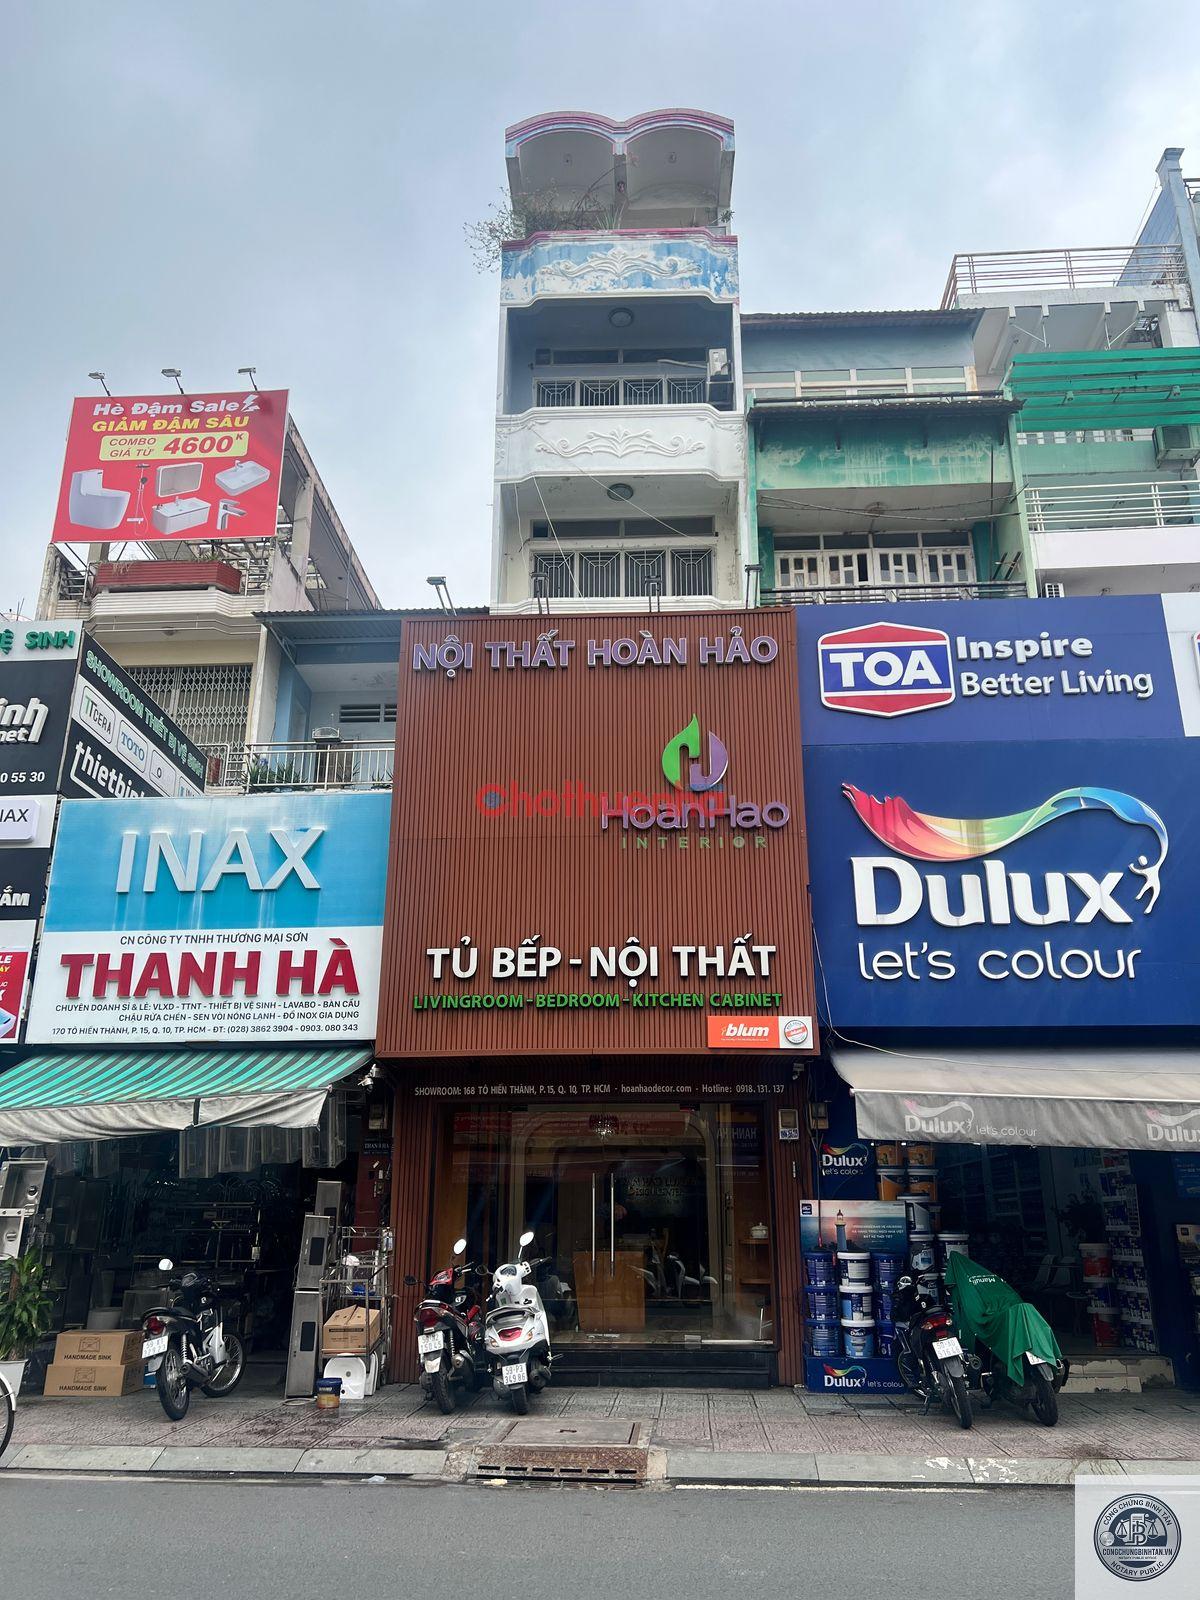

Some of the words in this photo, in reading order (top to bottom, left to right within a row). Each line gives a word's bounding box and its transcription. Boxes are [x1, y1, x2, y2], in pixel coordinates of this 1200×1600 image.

[93, 403, 125, 416] Hè
[131, 402, 183, 418] Đậm
[189, 399, 240, 413] Sale
[92, 416, 148, 432] GIẢM
[152, 416, 200, 433] ĐẬM
[205, 414, 250, 429] SÂU
[109, 438, 157, 447] COMBO
[109, 448, 132, 458] GIÁ
[25, 630, 76, 650] SINH
[956, 631, 1094, 665] Inspire
[412, 634, 473, 678] NỘI
[485, 629, 576, 669] THẤT
[587, 630, 687, 667] HOÀN
[700, 626, 779, 665] HẢO
[829, 649, 942, 688] TOA
[86, 650, 144, 718] SHOWROOM
[960, 671, 1055, 697] Better
[1060, 669, 1154, 699] Living
[121, 731, 145, 762] TOTO
[11, 772, 26, 783] 55
[30, 771, 45, 782] 30
[0, 808, 29, 822] AX
[601, 794, 791, 831] HoanHao
[622, 836, 768, 850] INTERIOR
[115, 828, 326, 894] INAX
[0, 885, 30, 907] ẮM
[850, 856, 1134, 927] Dulux
[120, 936, 135, 945] CN
[137, 934, 167, 945] CÔNG
[170, 935, 182, 944] TY
[185, 934, 214, 944] TNHH
[216, 933, 262, 944] THƯƠNG
[263, 933, 284, 945] MẠI
[285, 932, 309, 942] SƠN
[60, 950, 262, 1000] THANH
[275, 937, 361, 997] HÀ
[426, 935, 478, 979] TỦ
[493, 934, 561, 979] BẾP
[590, 936, 658, 988] NỘI
[672, 933, 777, 977] THẤT
[858, 941, 957, 980] let's
[977, 941, 1142, 980] colour
[55, 1003, 89, 1012] CHUYÊN
[91, 1003, 121, 1011] DOANH
[209, 1001, 232, 1010] THIẾT
[233, 1002, 242, 1011] BỊ
[243, 1001, 254, 1011] VỆ
[256, 1001, 276, 1009] SINH
[283, 1001, 316, 1009] LAVABO
[413, 993, 524, 1010] LIVINGROOM
[536, 993, 620, 1009] BEDROOM
[632, 992, 704, 1008] KITCHEN
[710, 992, 783, 1008] CABINET
[118, 1013, 143, 1023] CHẬU
[193, 1013, 210, 1021] SEN
[226, 1011, 251, 1020] NÓNG
[252, 1012, 276, 1021] LẠNH
[297, 1011, 317, 1019] INOX
[319, 1011, 333, 1019] GIA
[335, 1011, 360, 1021] DỤNG
[140, 1027, 150, 1035] 15,
[152, 1026, 160, 1034] Q.
[162, 1026, 173, 1035] 10,
[174, 1026, 185, 1034] TP.
[212, 1025, 225, 1033] ĐT:
[227, 1025, 249, 1034] (028)
[250, 1025, 271, 1033] 3862
[324, 1024, 341, 1032] 080
[725, 1023, 770, 1037] blum
[414, 1086, 462, 1096] SHOWROOM:
[463, 1086, 475, 1095] 168
[581, 1084, 591, 1094] TP.
[594, 1084, 611, 1094] HCM
[621, 1083, 692, 1094] hoanhaodecor.com
[702, 1083, 732, 1094] Hotline:
[904, 1114, 967, 1134] Dulux
[976, 1124, 998, 1136] let's
[1000, 1125, 1038, 1137] colour
[822, 1154, 864, 1167] Dulux
[824, 1375, 862, 1388] Dulux
